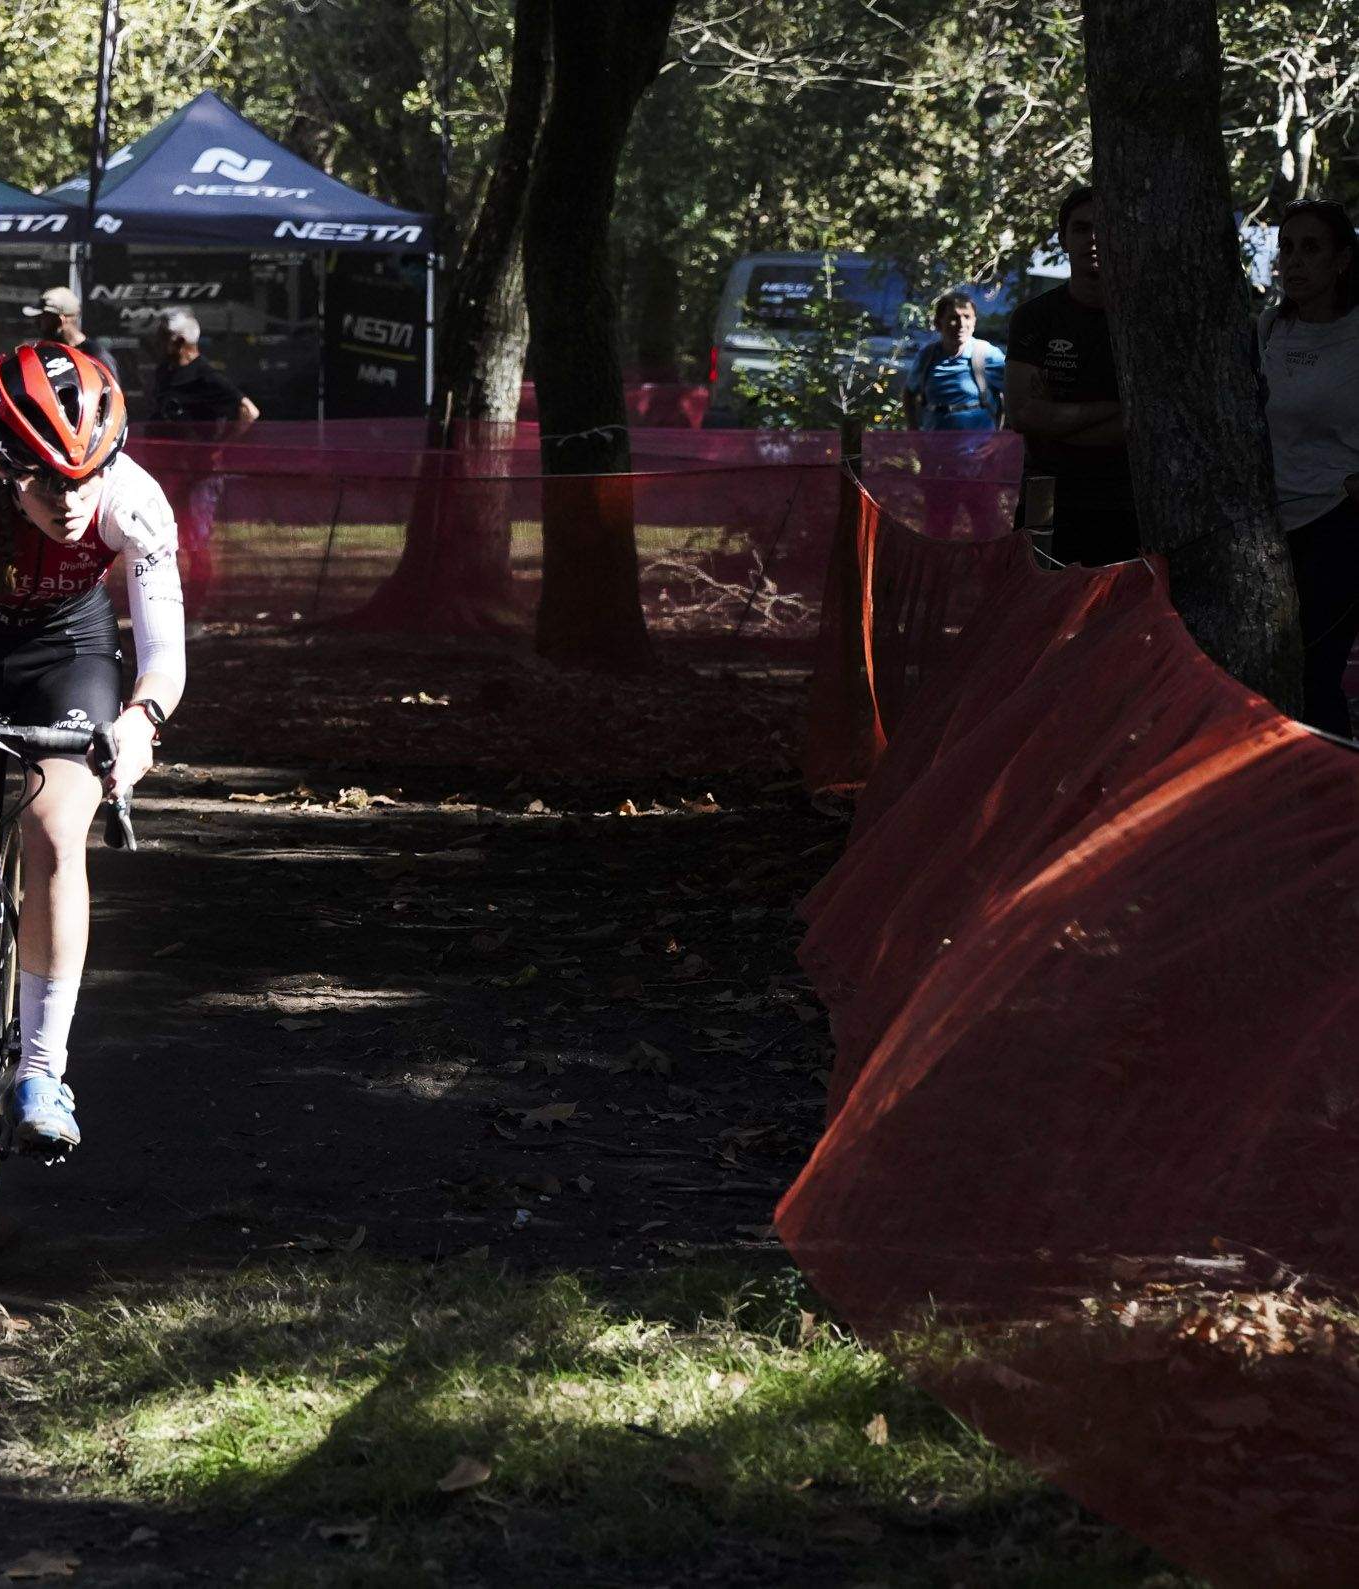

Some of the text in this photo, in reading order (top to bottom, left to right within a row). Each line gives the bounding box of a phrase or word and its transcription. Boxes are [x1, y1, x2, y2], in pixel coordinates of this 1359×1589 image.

[172, 184, 315, 199] NESTA
[273, 220, 423, 243] NESTA
[89, 282, 223, 301] NESTA
